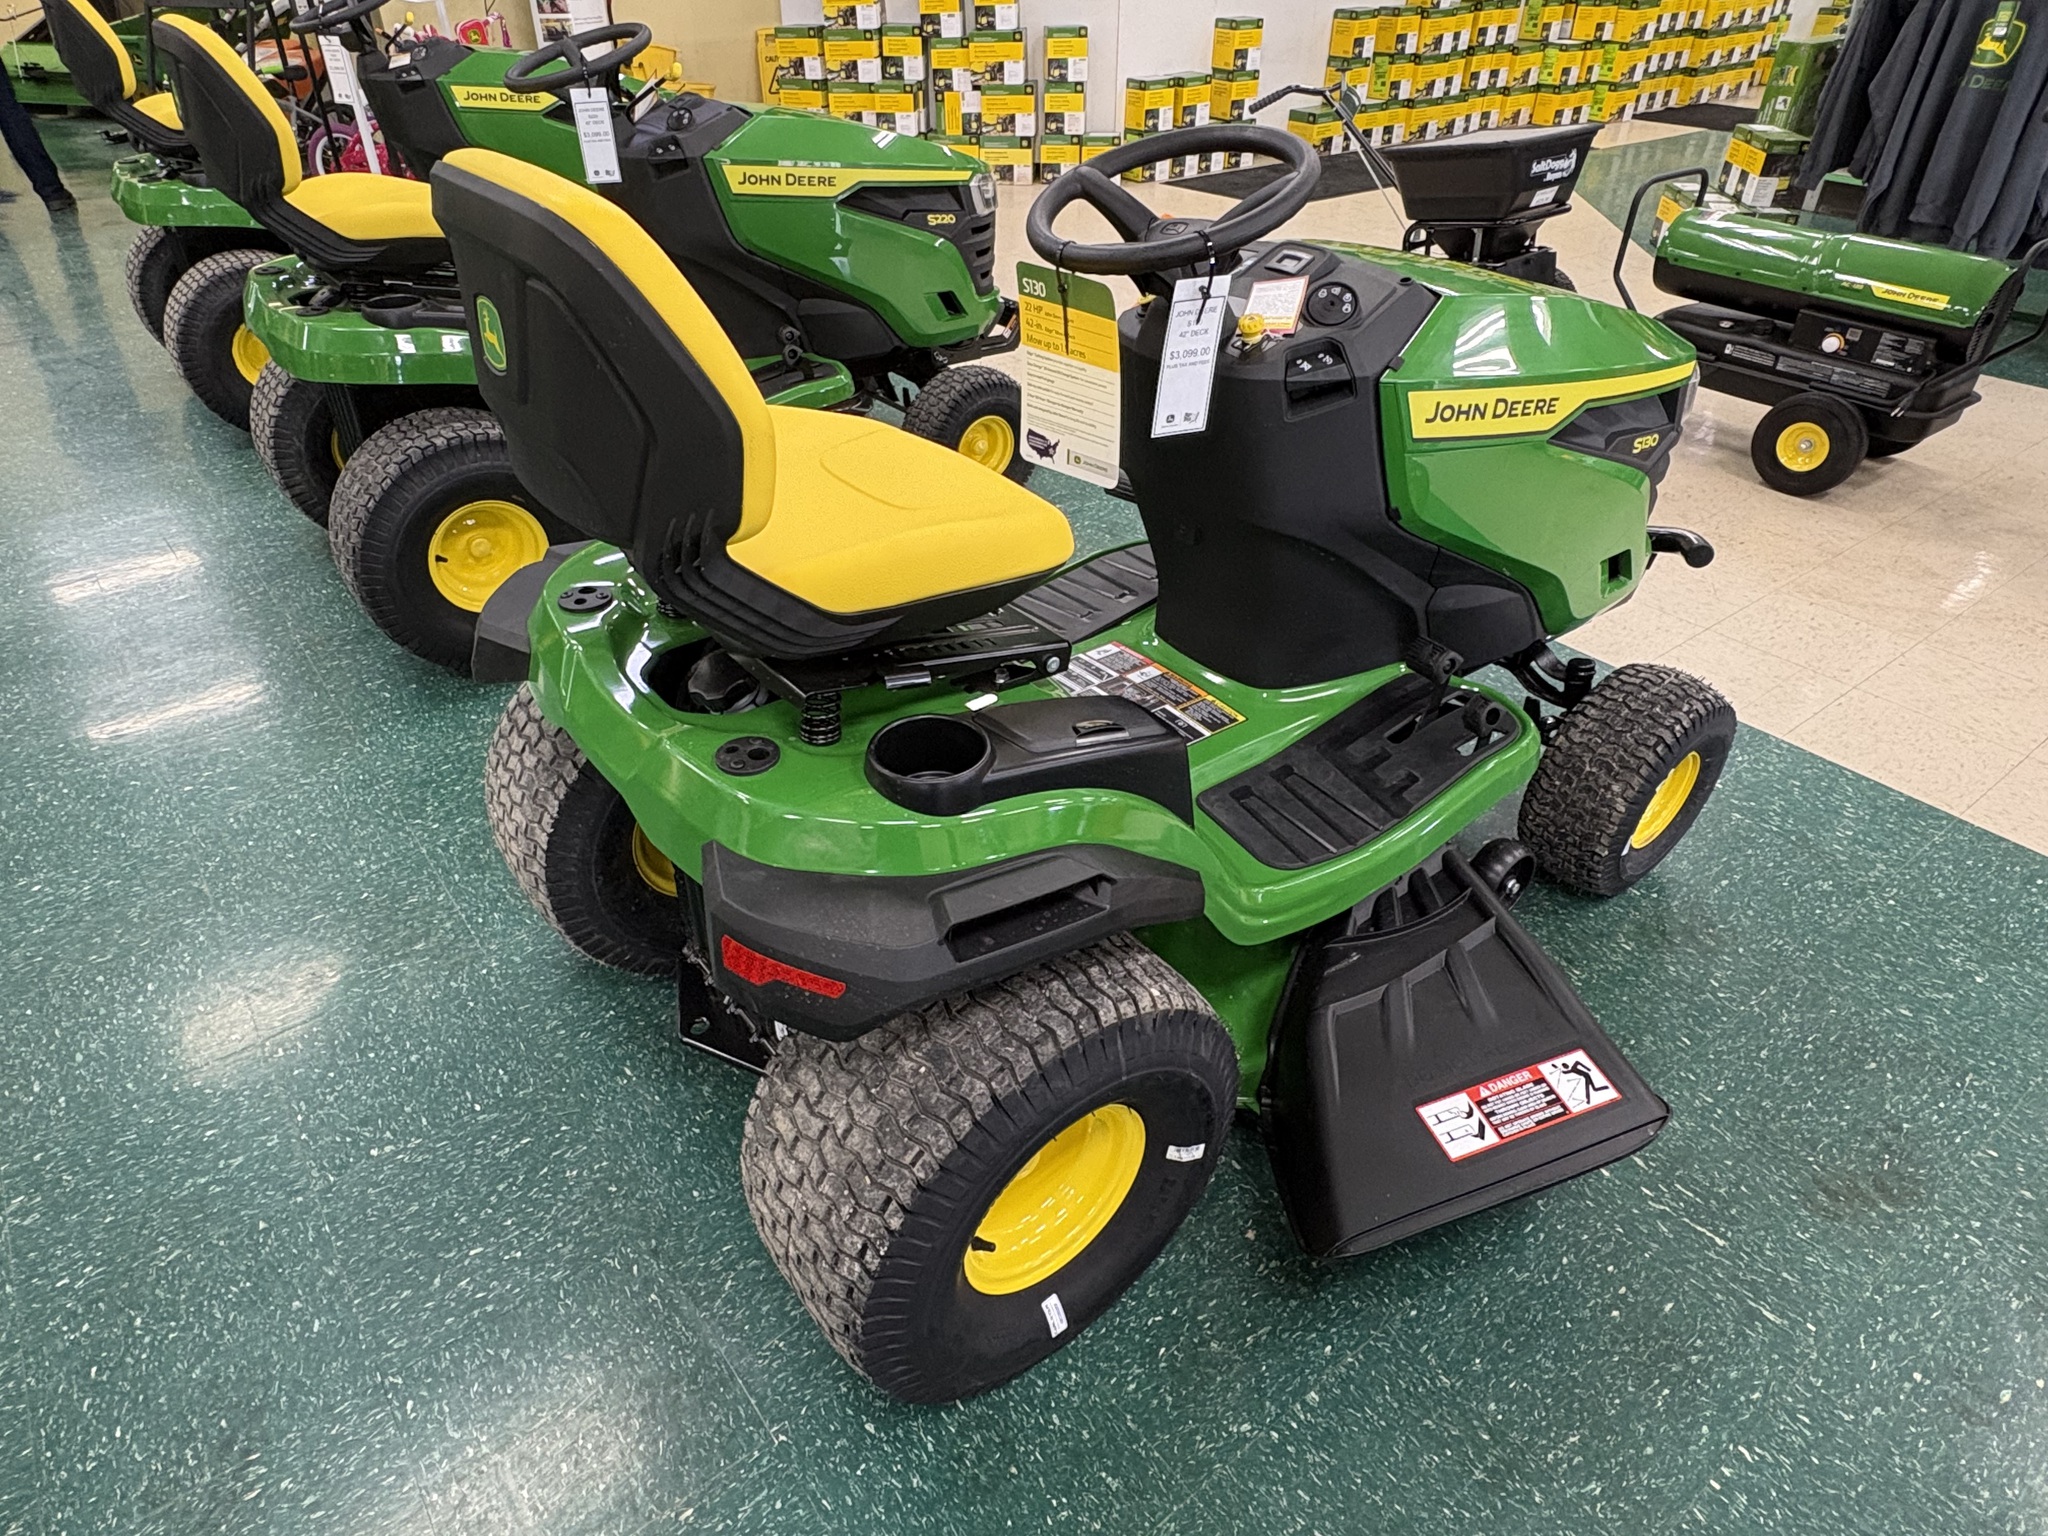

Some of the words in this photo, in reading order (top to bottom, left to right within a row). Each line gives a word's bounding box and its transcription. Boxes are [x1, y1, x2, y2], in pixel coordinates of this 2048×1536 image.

[463, 90, 498, 102] JOHN
[499, 92, 542, 104] DEERE
[738, 171, 782, 186] JOHN
[785, 173, 837, 187] DEERE
[926, 213, 956, 226] S220
[1022, 277, 1047, 298] S130
[1881, 288, 1908, 298] JOHN
[1024, 301, 1032, 312] 22
[1032, 304, 1043, 314] HP
[1175, 309, 1194, 318] JOHN
[1190, 327, 1210, 338] DECK
[1026, 333, 1043, 346] Mow
[1043, 340, 1052, 351] up
[1052, 341, 1060, 351] to
[1069, 348, 1087, 360] acres
[1169, 346, 1211, 361] $3,099.00
[1425, 401, 1488, 424] JOHN
[1491, 397, 1561, 420] DEERE
[1631, 433, 1660, 454] S130
[1487, 1070, 1533, 1093] DANGER
